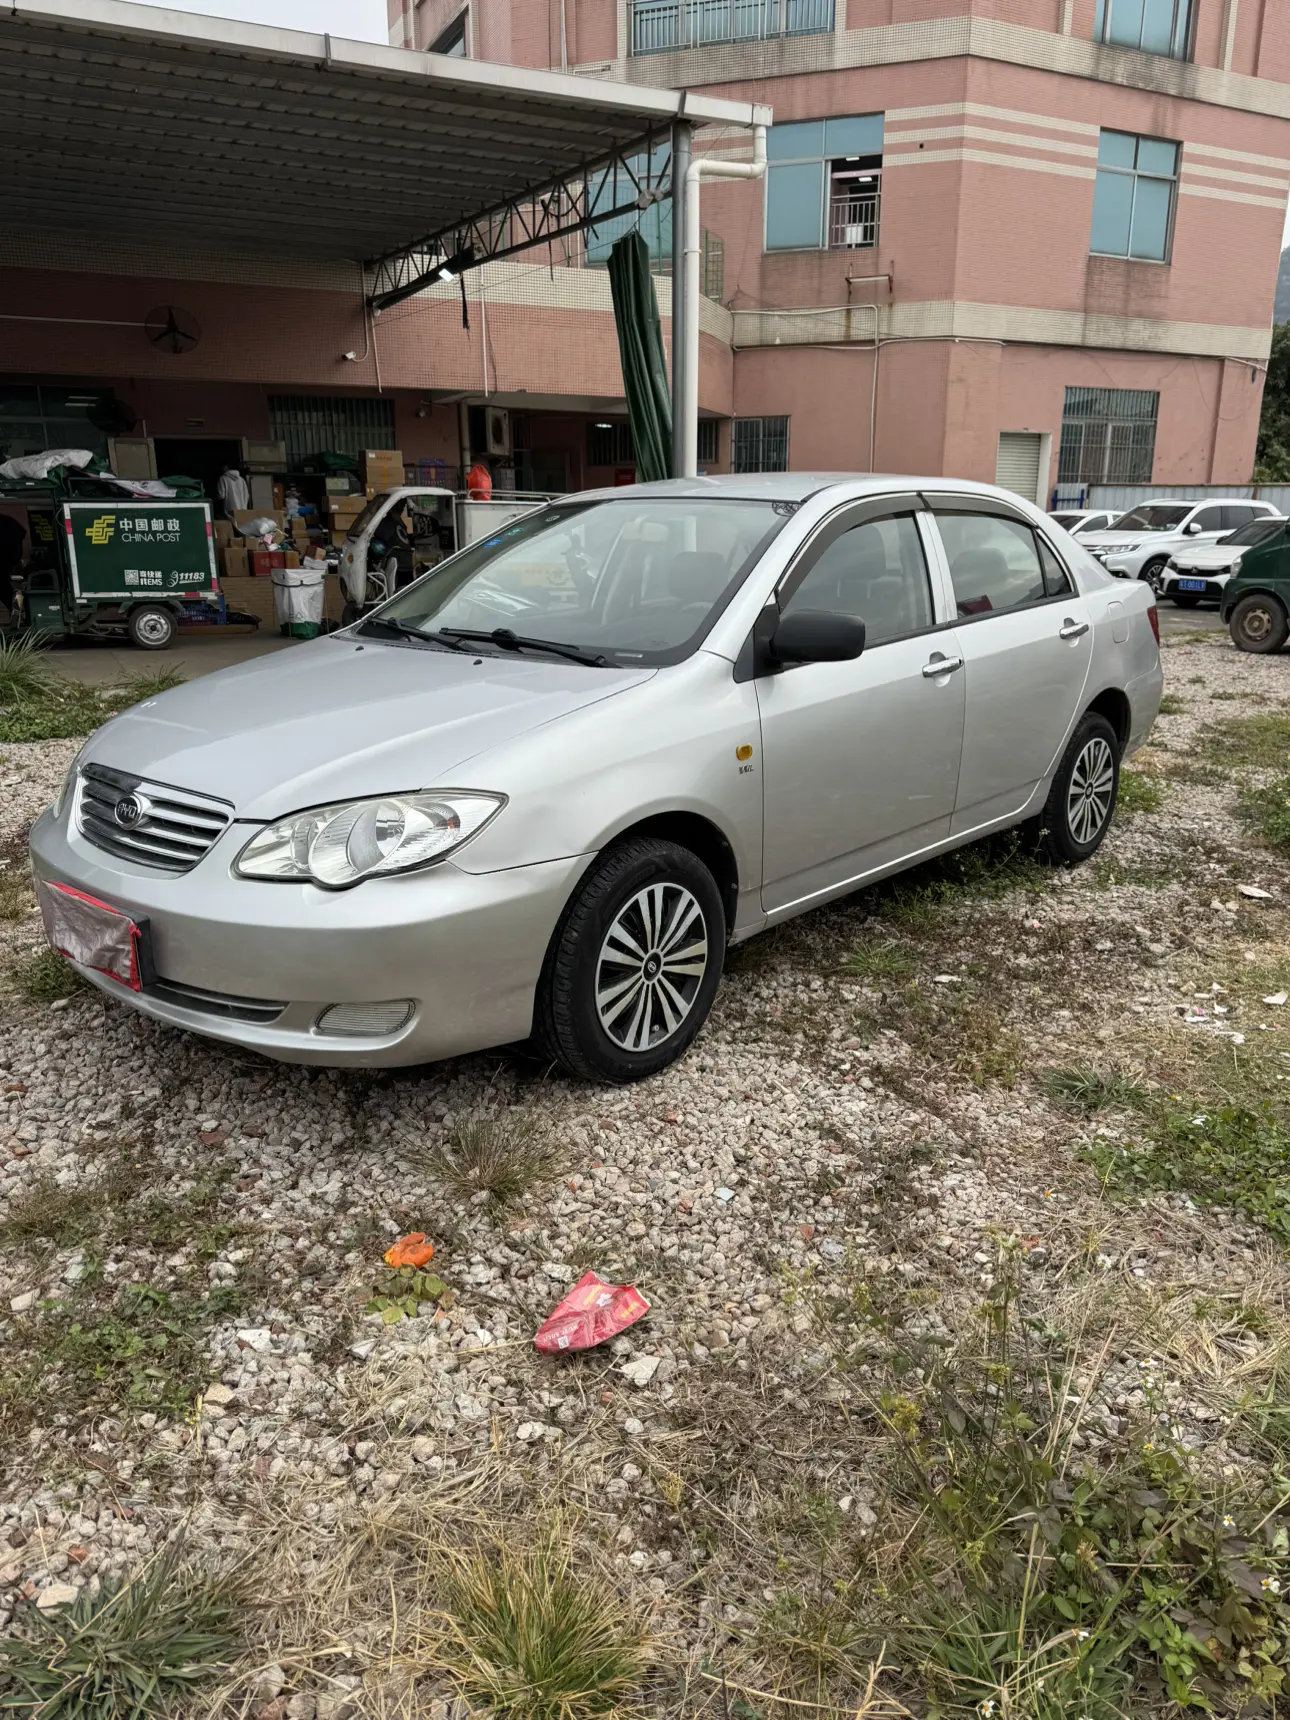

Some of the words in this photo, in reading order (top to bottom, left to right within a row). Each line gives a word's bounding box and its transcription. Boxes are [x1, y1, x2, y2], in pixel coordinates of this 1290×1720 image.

[119, 518, 180, 531] 中国邮政
[121, 533, 155, 542] CHINA
[156, 533, 181, 542] POST
[179, 572, 205, 580] 11183
[118, 803, 136, 818] BYD
